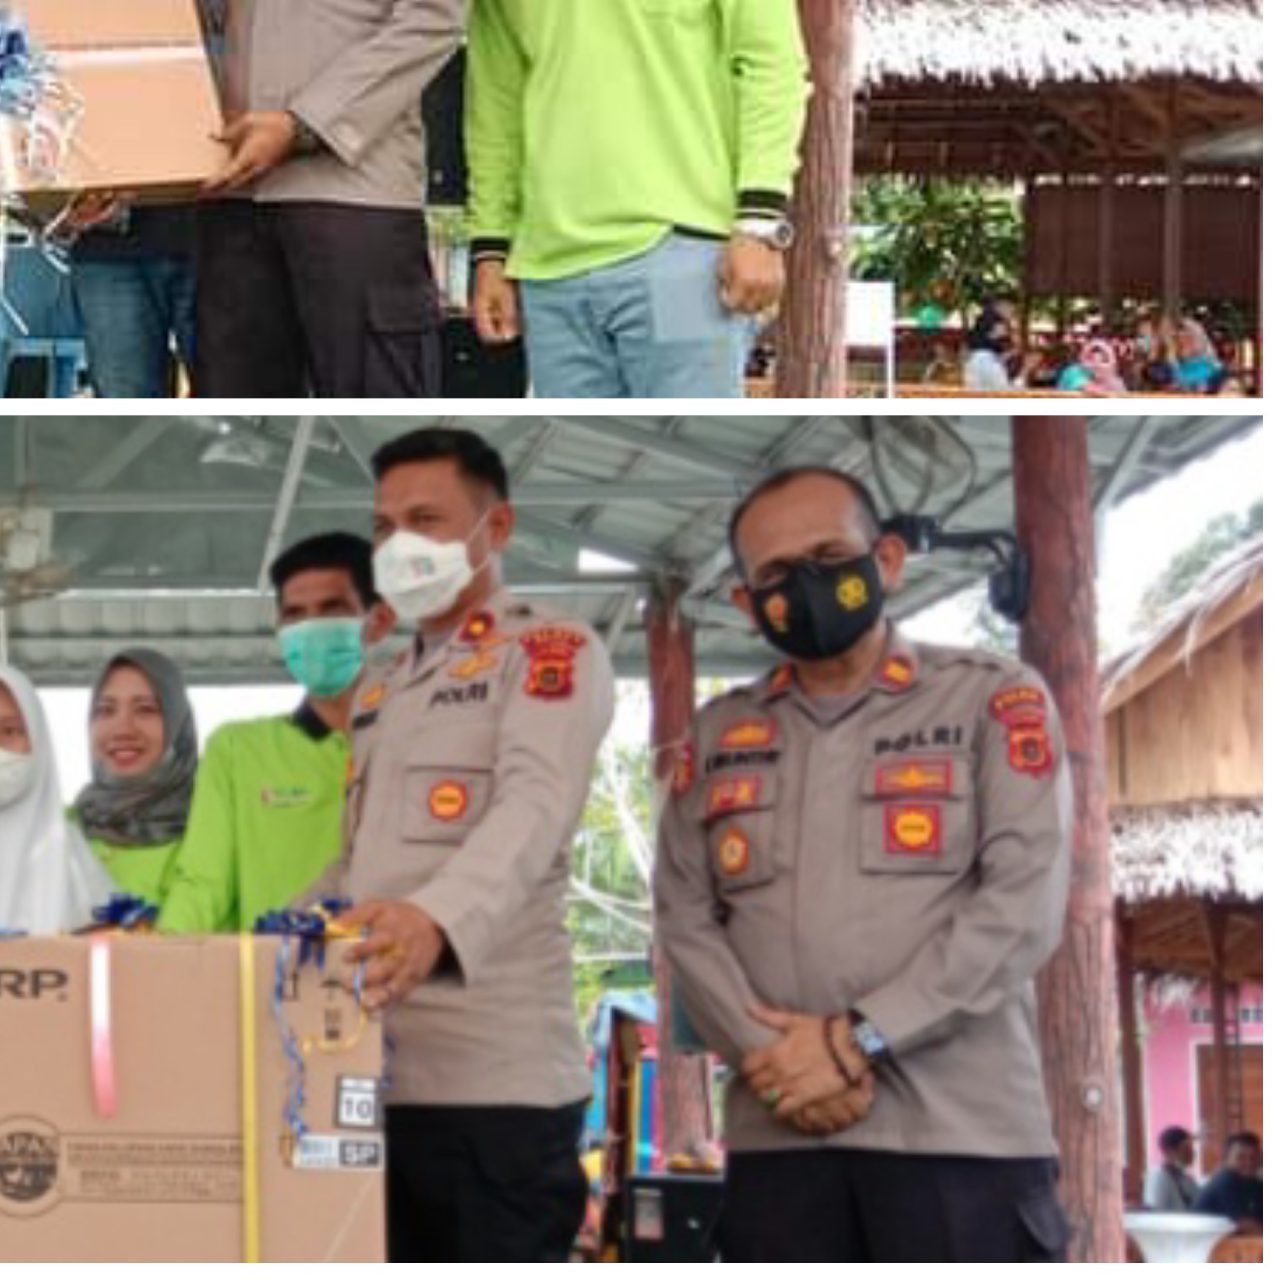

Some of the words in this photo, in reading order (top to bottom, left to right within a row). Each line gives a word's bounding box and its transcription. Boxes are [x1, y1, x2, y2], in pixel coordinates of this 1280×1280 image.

[429, 683, 488, 707] POLRI
[874, 726, 962, 754] POLRI
[345, 1099, 373, 1119] 10
